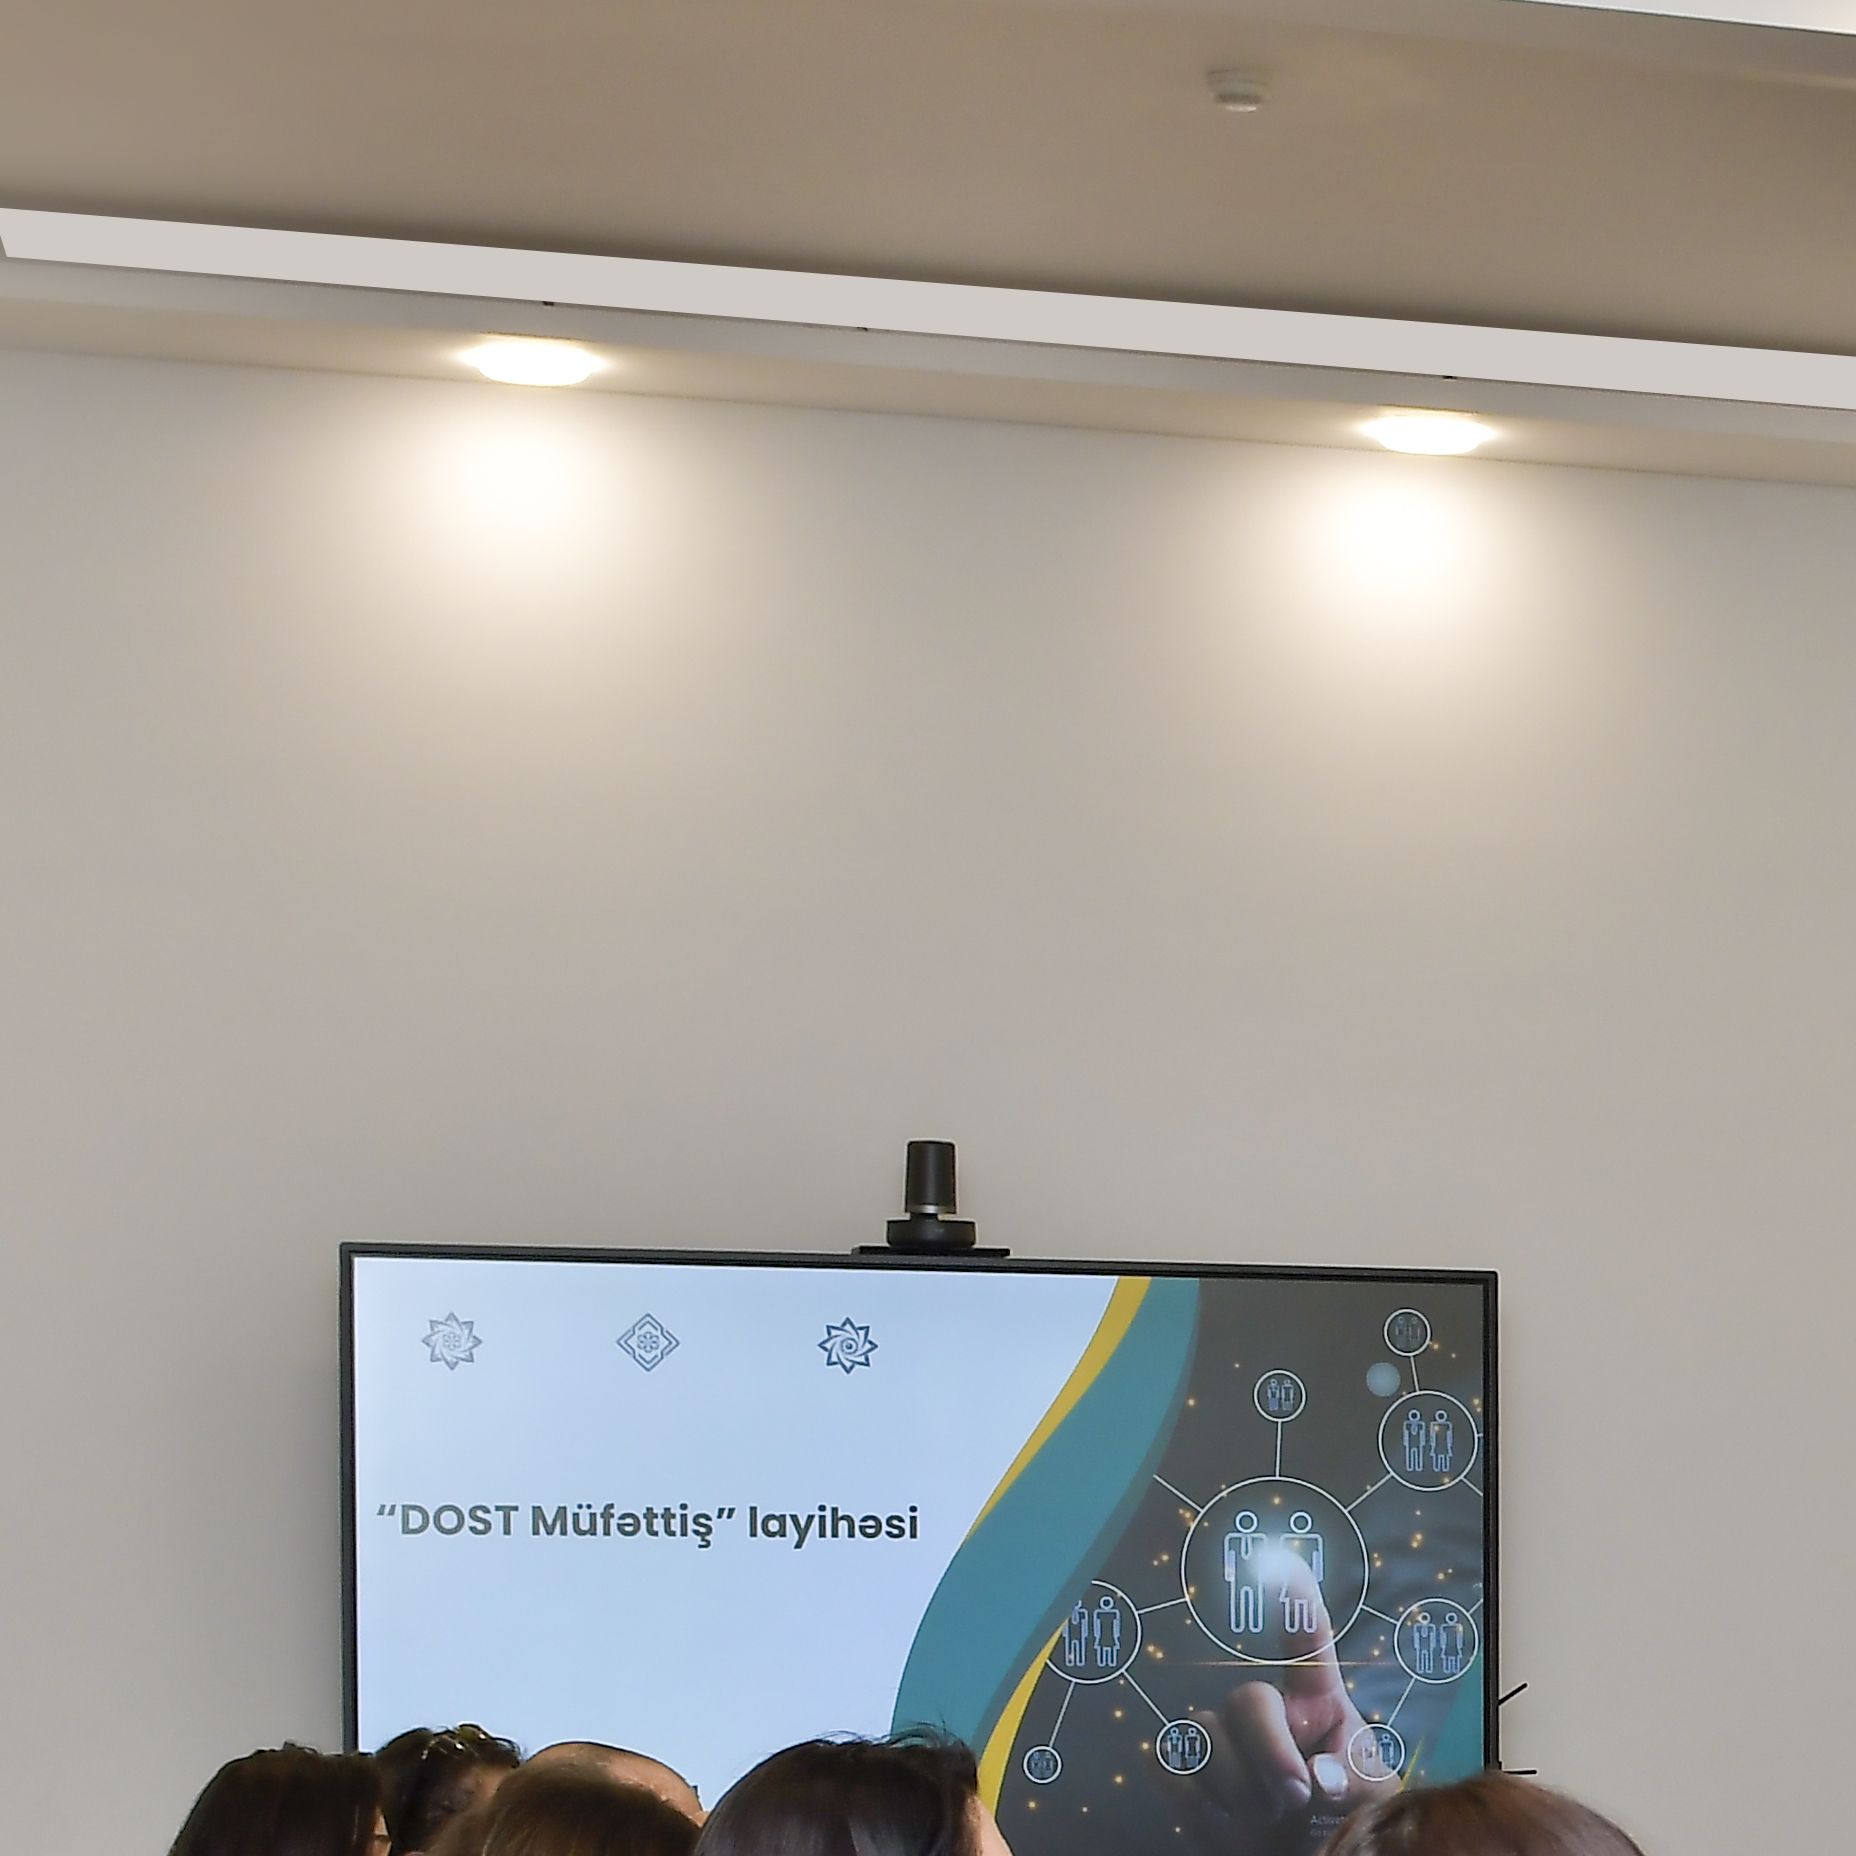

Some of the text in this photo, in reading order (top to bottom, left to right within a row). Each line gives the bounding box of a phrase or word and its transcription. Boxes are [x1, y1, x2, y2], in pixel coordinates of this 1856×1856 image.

[376, 1503, 919, 1550] “DOST Müfəttiş” layihəsi
